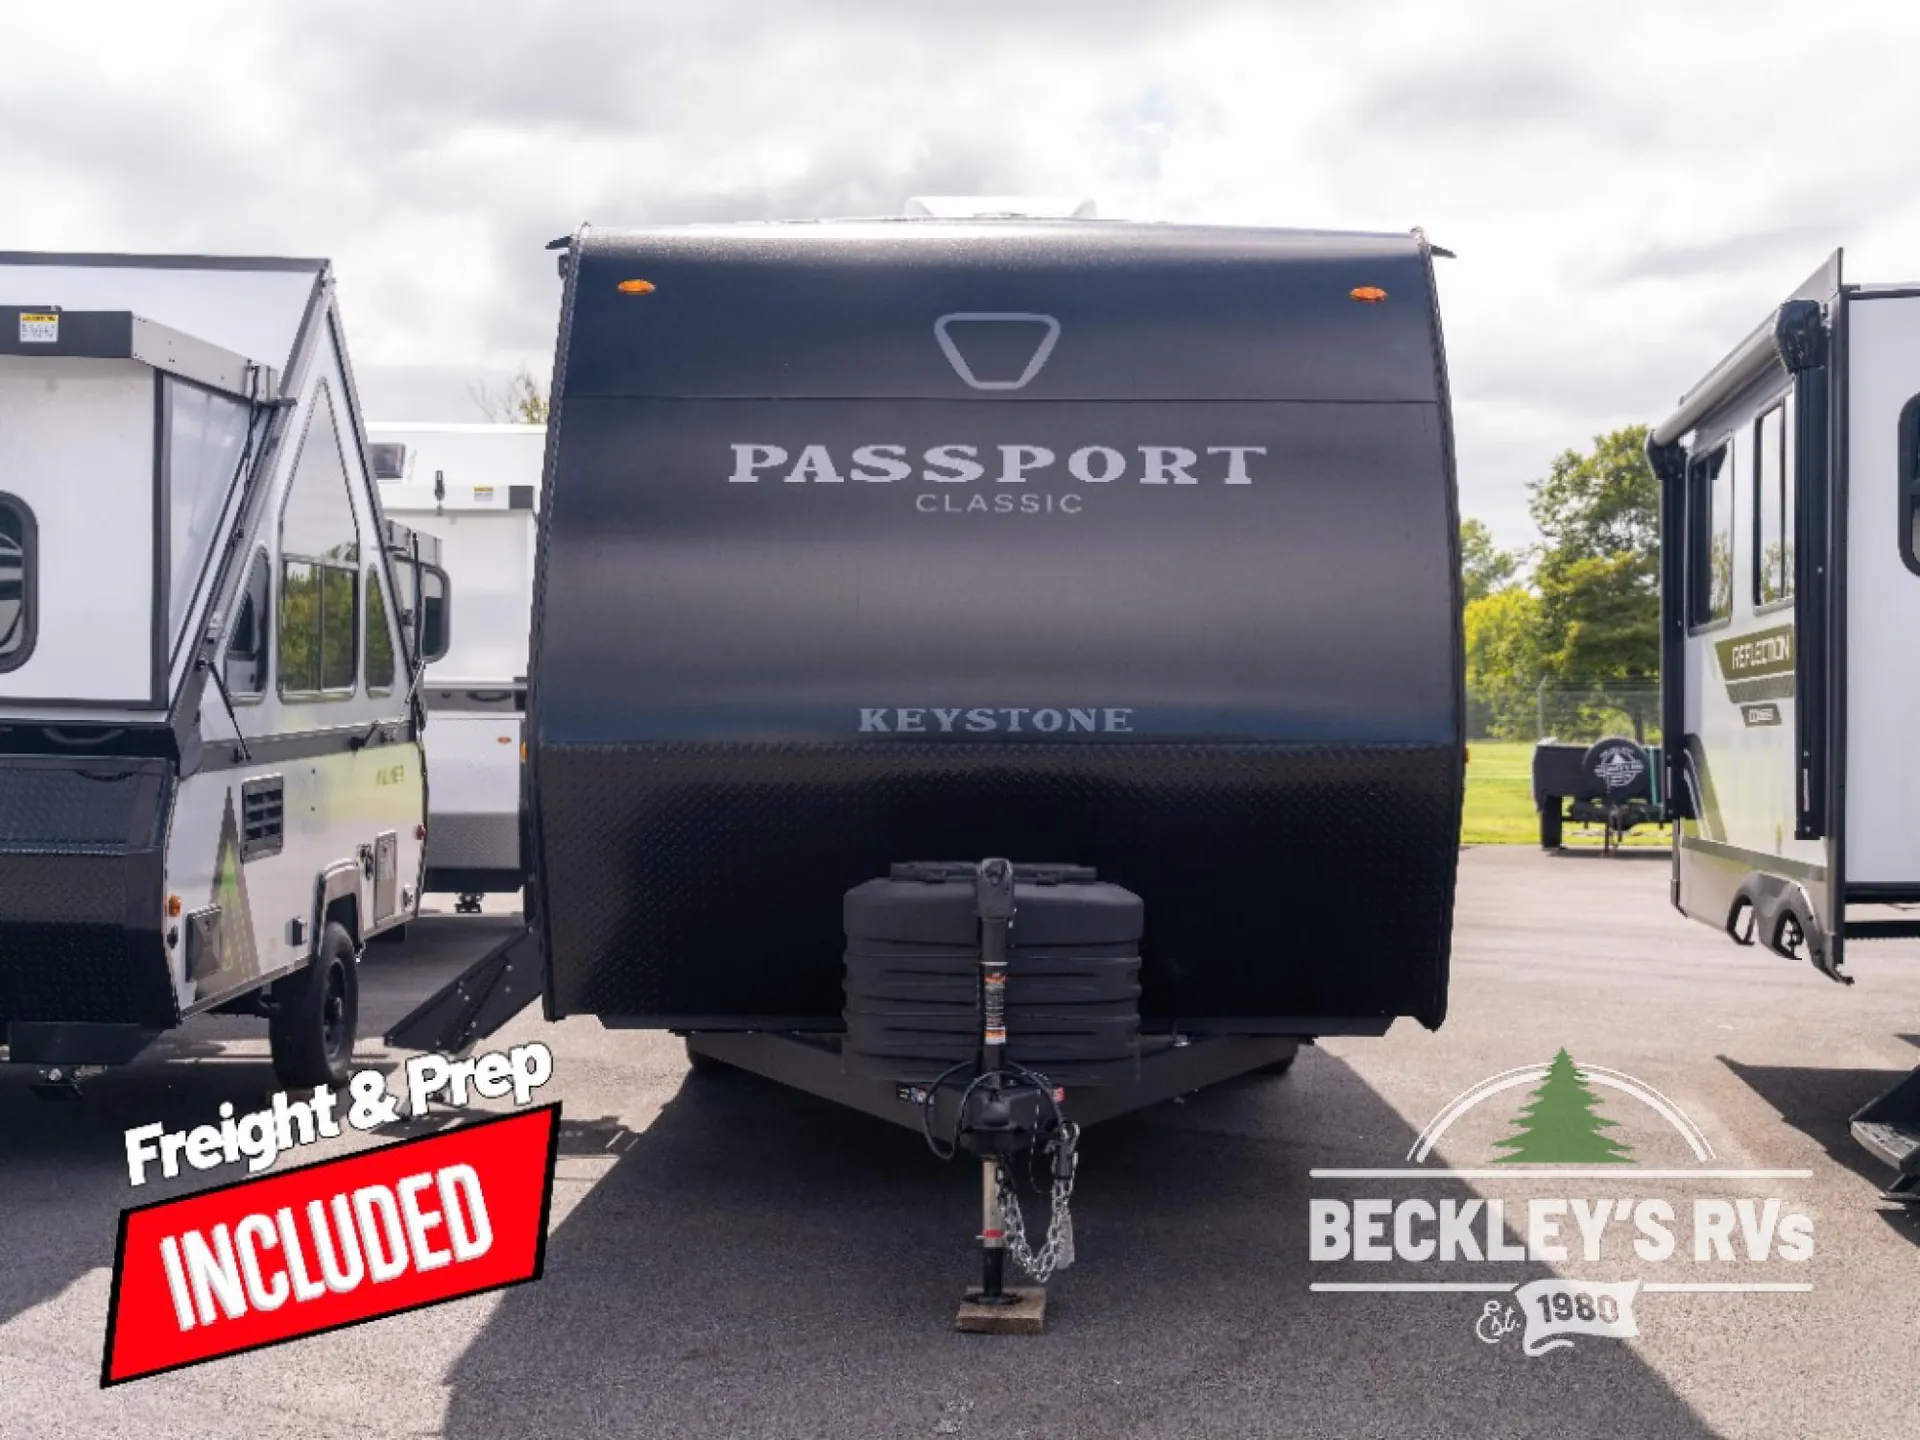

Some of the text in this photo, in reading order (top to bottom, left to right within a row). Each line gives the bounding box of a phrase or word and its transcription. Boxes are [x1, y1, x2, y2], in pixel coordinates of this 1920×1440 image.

[728, 443, 1267, 485] PASSPORT
[916, 493, 1083, 513] CLASSIC
[859, 708, 1134, 733] KEYSTONE
